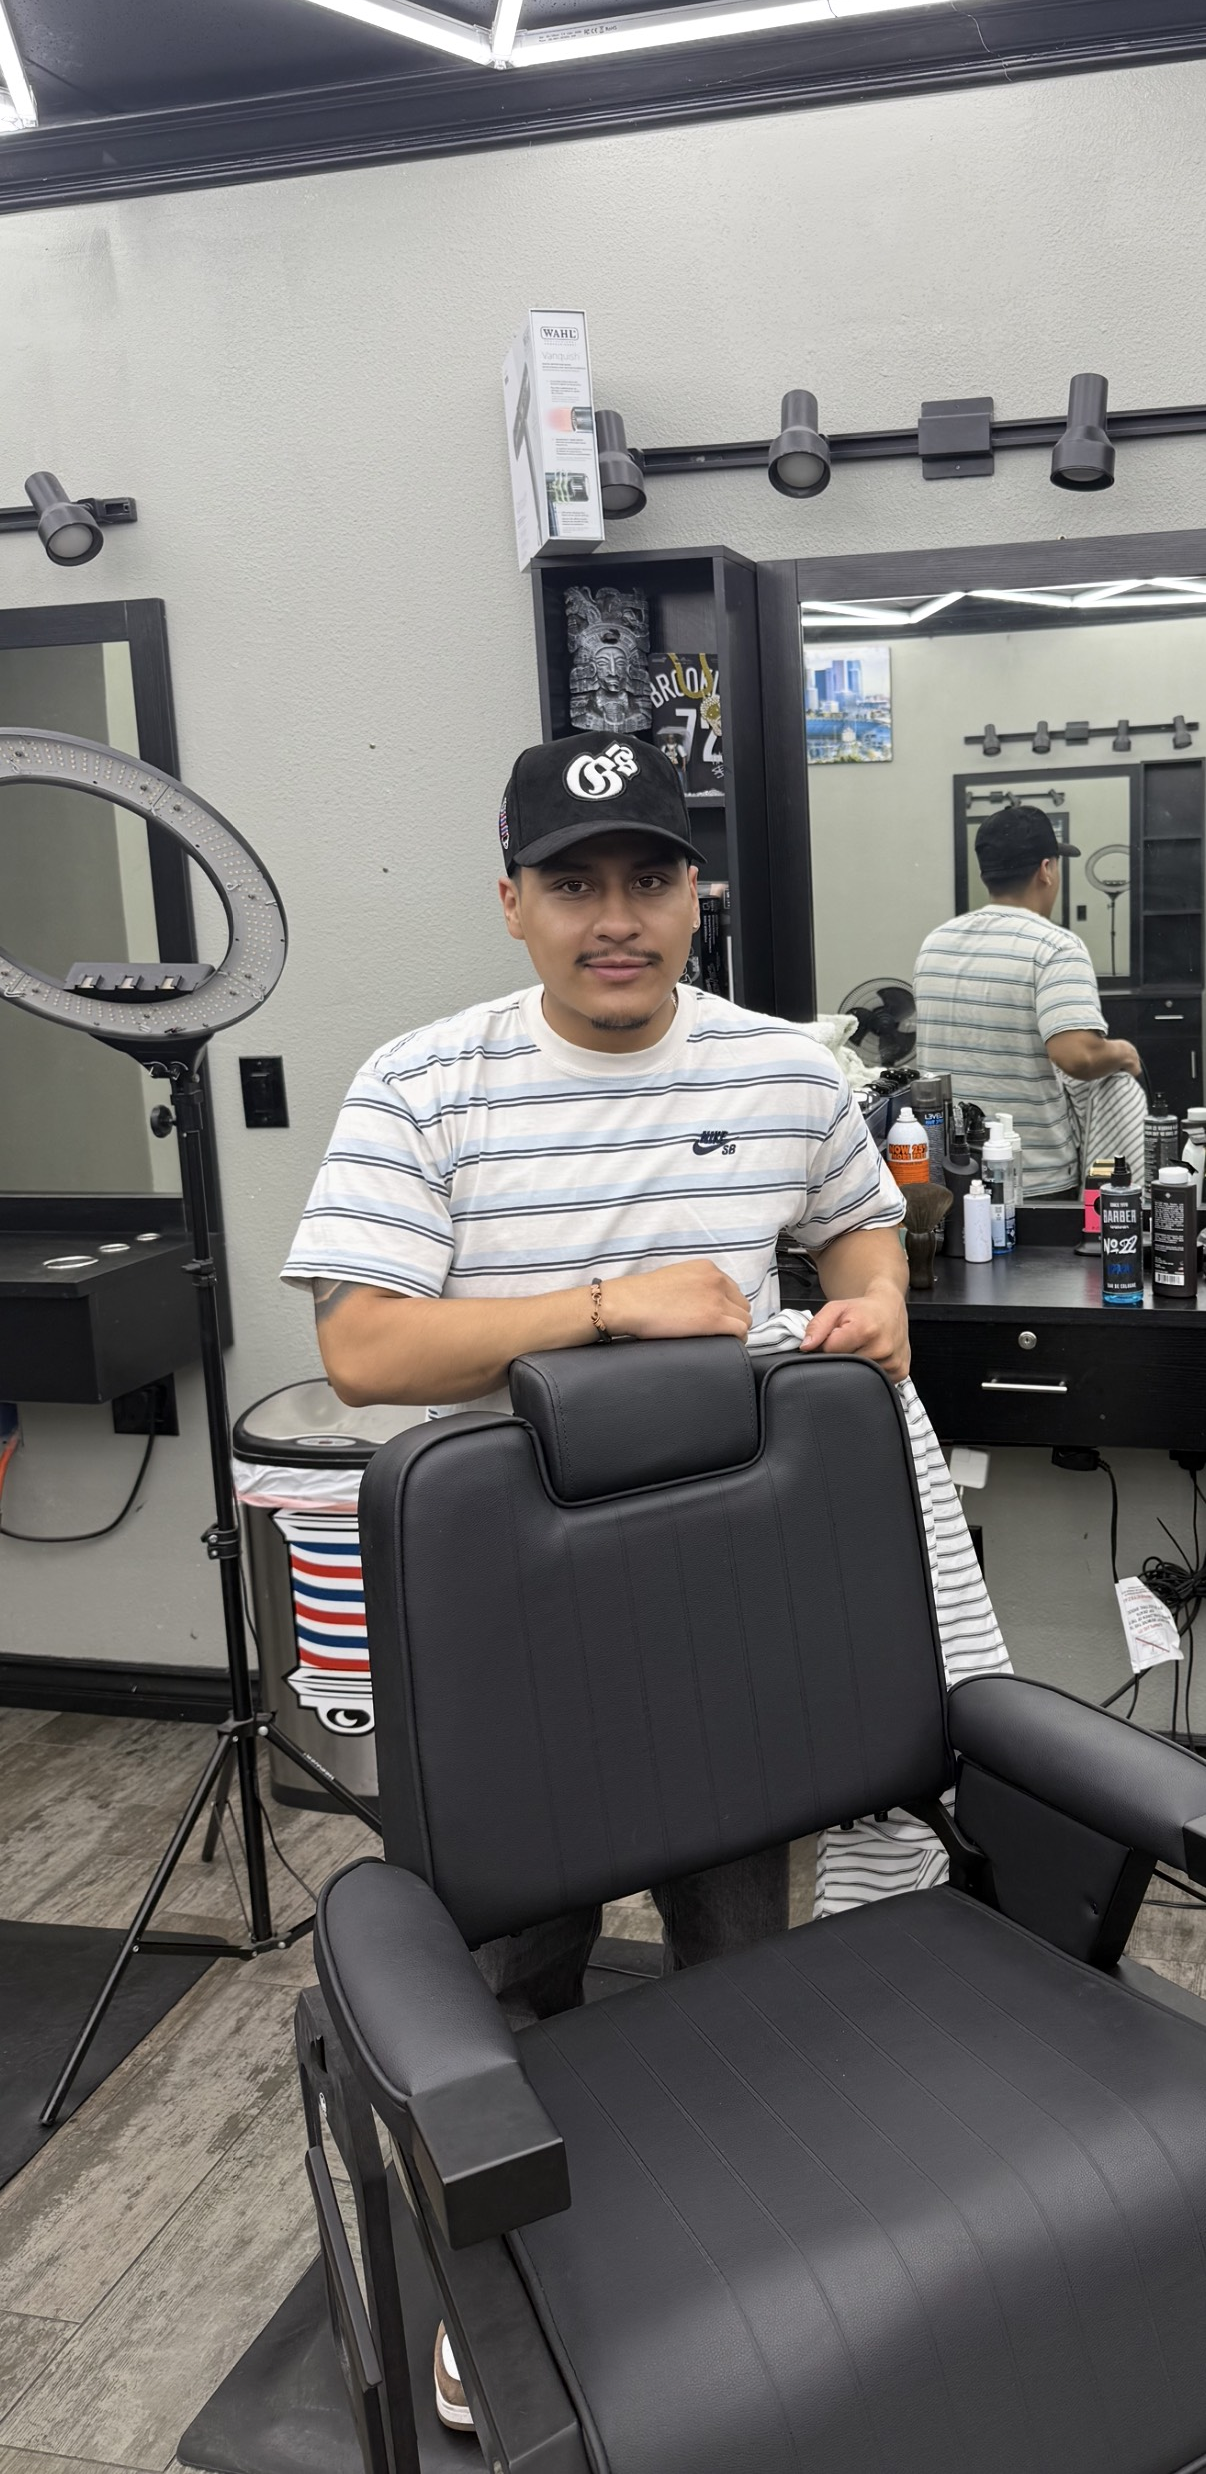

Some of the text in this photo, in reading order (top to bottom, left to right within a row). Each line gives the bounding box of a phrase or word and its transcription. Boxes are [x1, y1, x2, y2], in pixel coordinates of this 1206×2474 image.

[543, 329, 577, 338] WAHL
[722, 1144, 736, 1155] SB
[1103, 1210, 1136, 1223] BARBER
